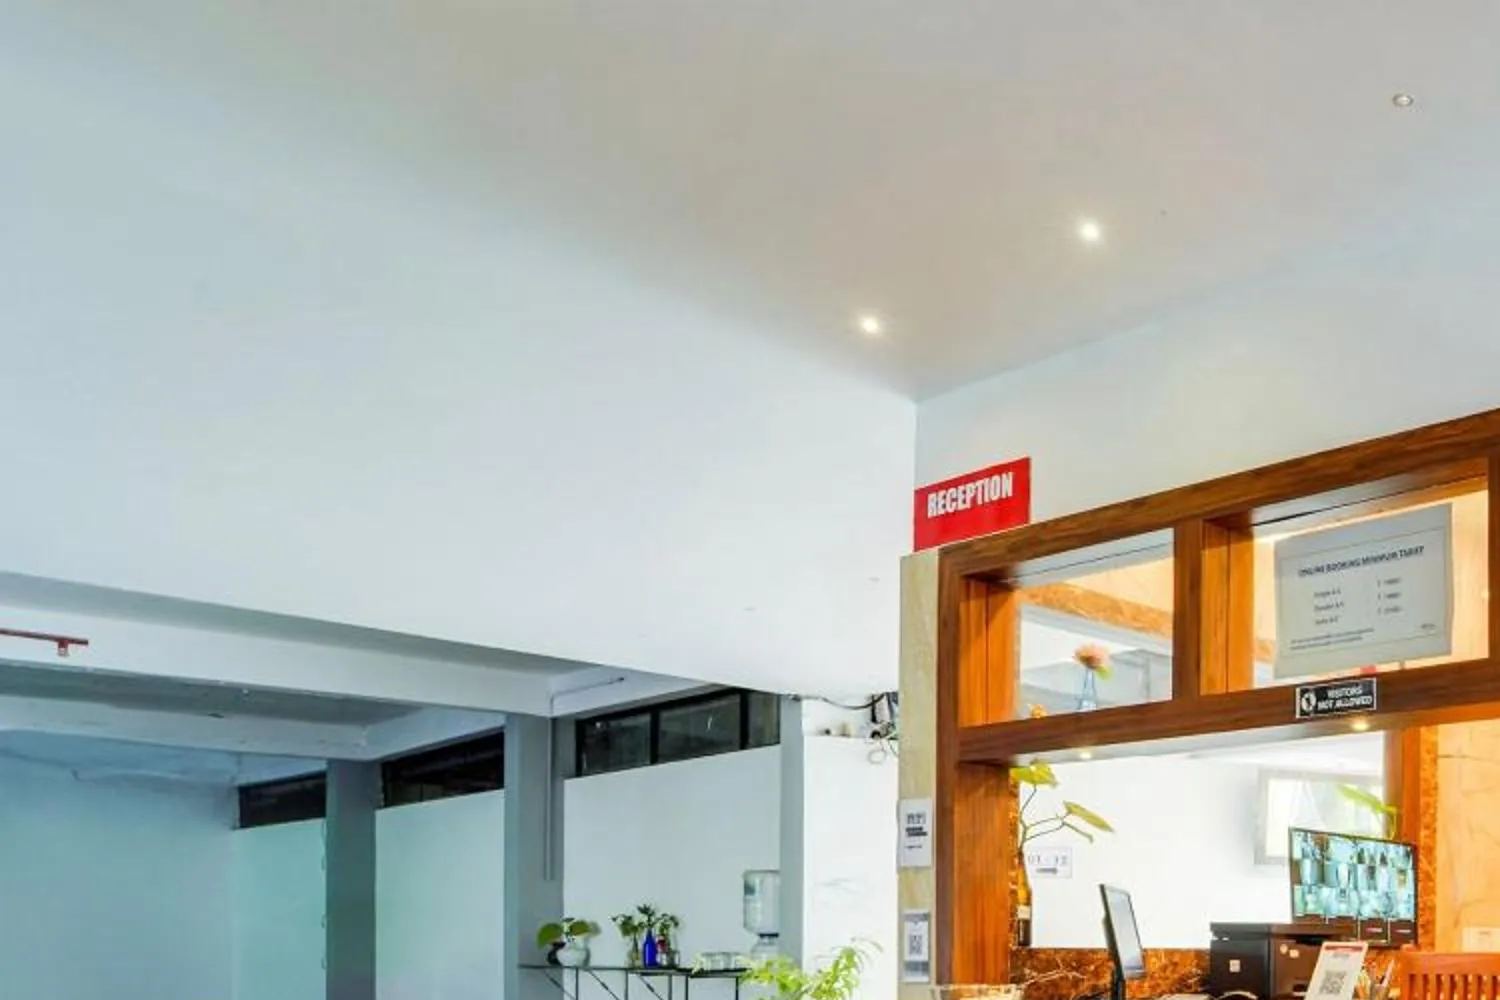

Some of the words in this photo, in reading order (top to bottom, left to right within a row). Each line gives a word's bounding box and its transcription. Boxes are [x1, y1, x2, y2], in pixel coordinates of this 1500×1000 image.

[928, 472, 1013, 518] RECEPTION
[1317, 700, 1334, 710] NOT
[1335, 696, 1373, 707] ALLOWED
